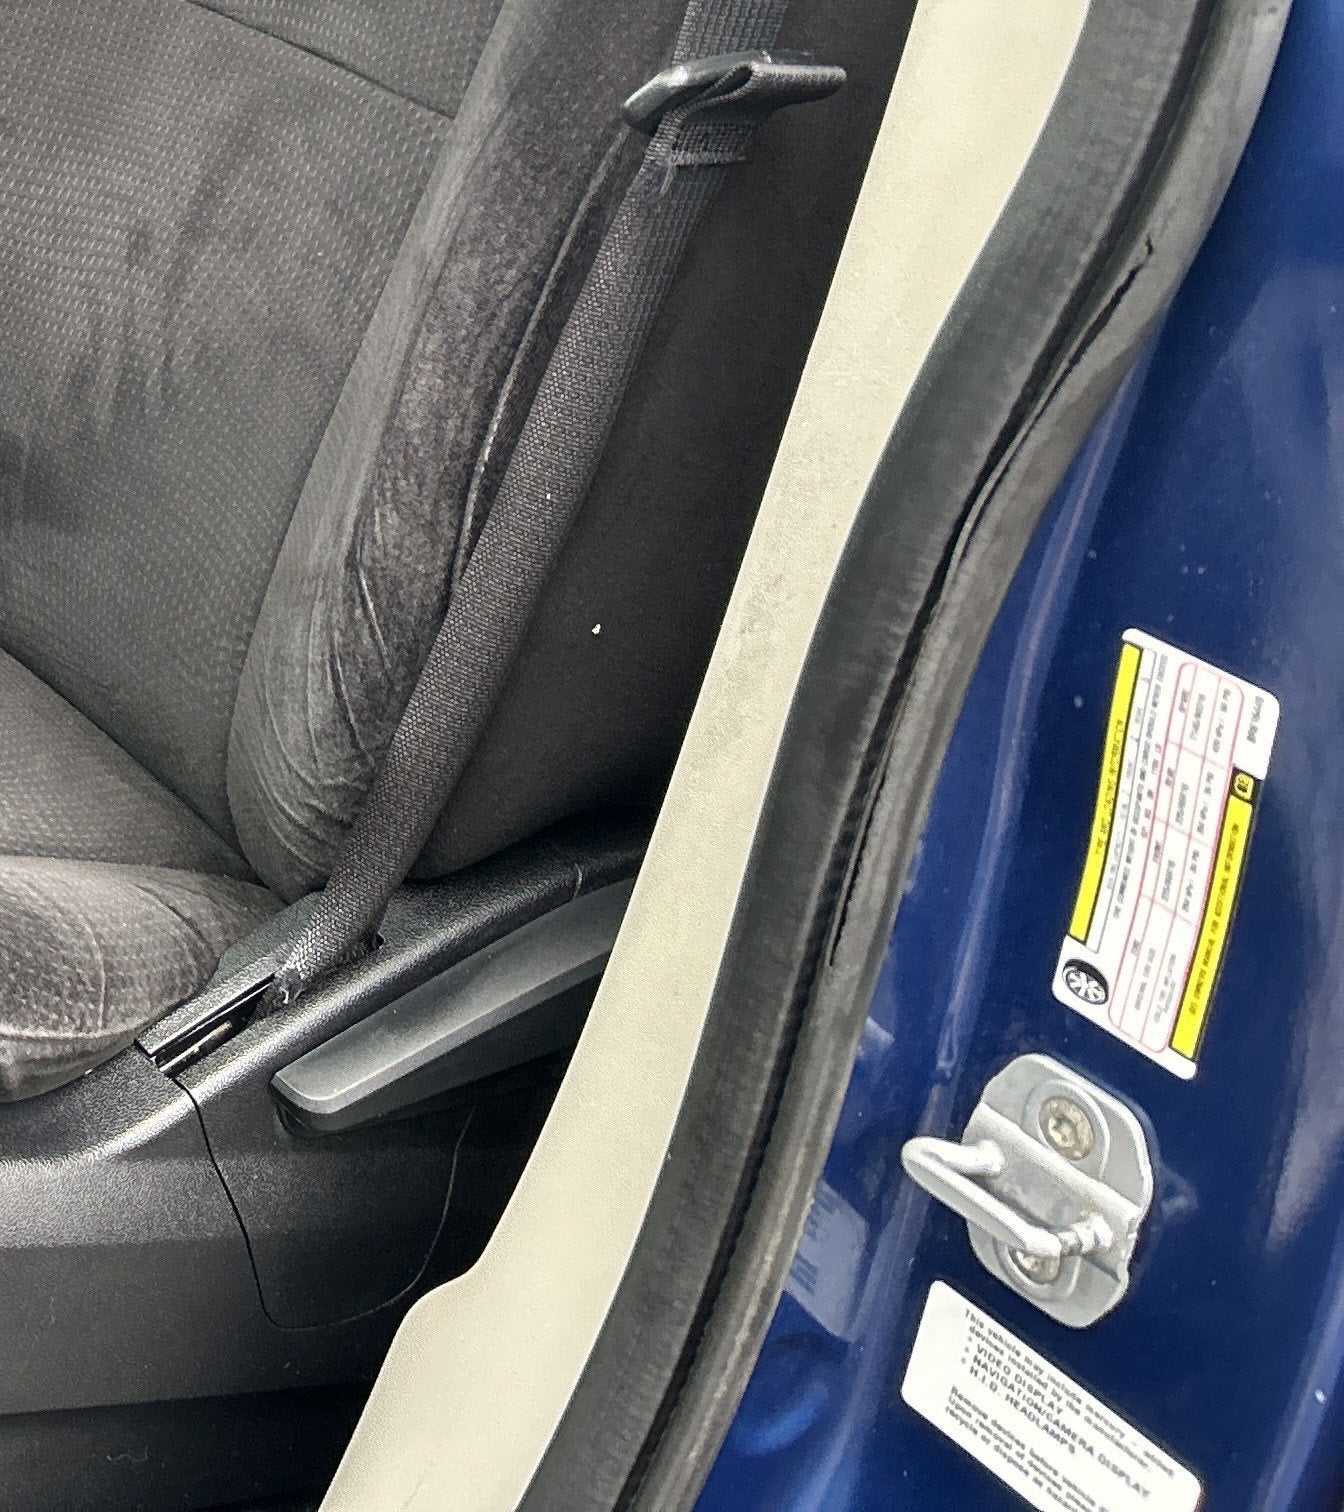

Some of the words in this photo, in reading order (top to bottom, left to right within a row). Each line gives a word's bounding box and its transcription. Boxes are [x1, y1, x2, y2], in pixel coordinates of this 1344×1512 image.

[973, 1354, 1094, 1456] NAVIGATION/CAMERA
[977, 1343, 1011, 1375] VIDEO
[1014, 1373, 1063, 1415] DISPLAY
[1005, 1393, 1076, 1455] HEADLAMPS
